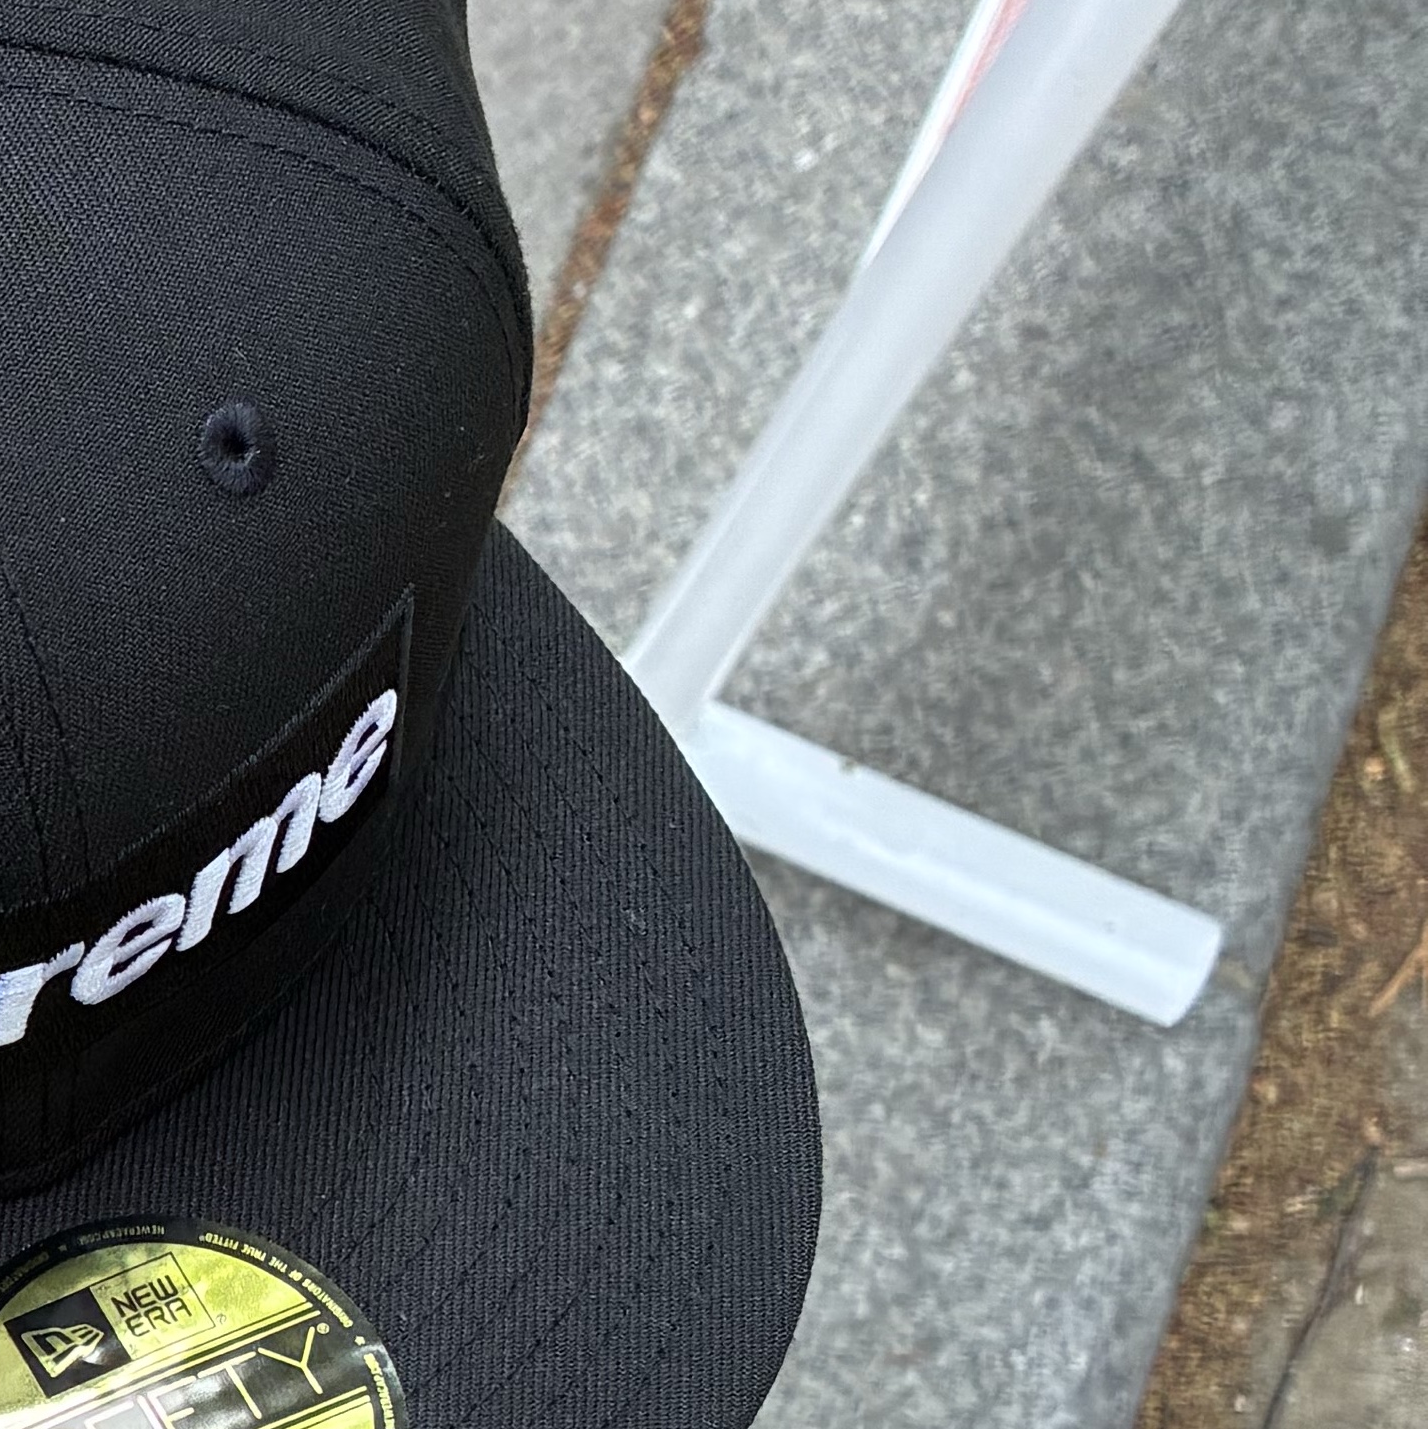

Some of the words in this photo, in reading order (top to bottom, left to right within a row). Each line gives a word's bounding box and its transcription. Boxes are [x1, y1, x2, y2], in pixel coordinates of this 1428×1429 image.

[241, 1244, 267, 1262] TRUE
[269, 1256, 288, 1273] THE
[110, 1274, 180, 1318] NEW
[125, 1297, 193, 1337] ERA
